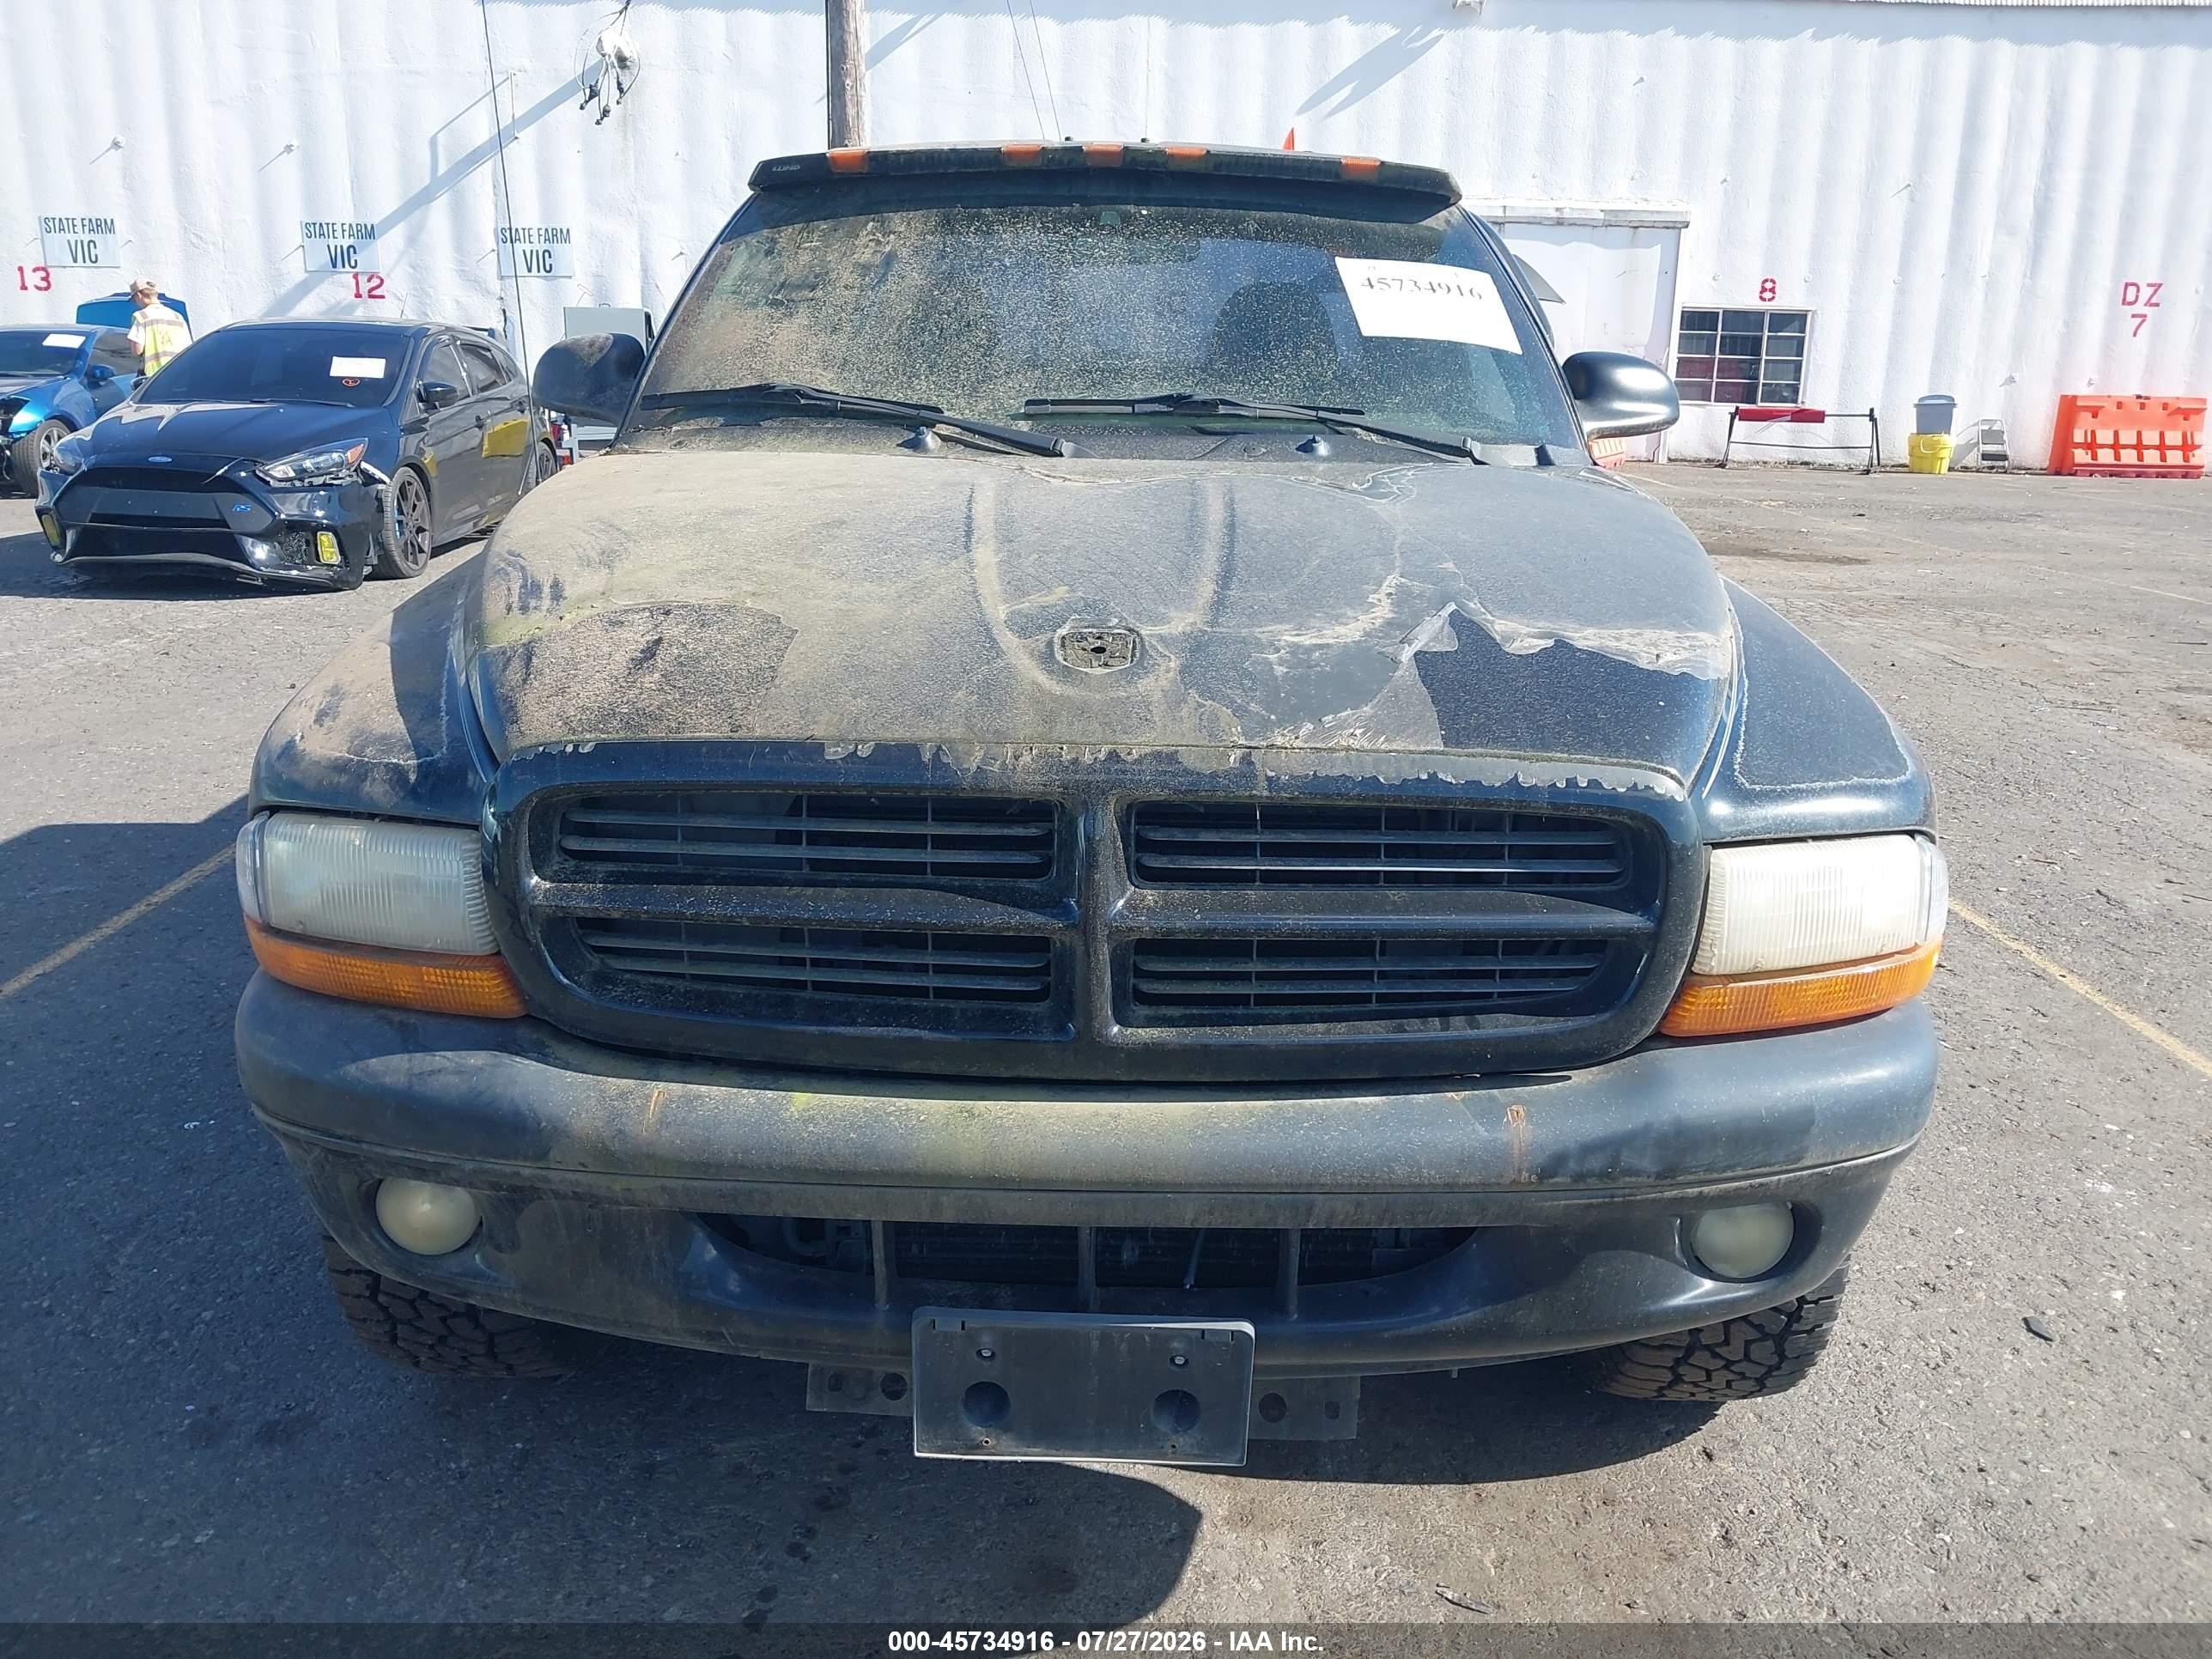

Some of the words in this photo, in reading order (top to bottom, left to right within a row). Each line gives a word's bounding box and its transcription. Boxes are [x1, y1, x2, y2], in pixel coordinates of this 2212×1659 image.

[44, 216, 78, 234] STATE
[81, 218, 116, 234] FARM
[305, 222, 338, 239] STATE
[341, 222, 375, 240] FARM
[537, 228, 571, 244] FARM
[67, 240, 98, 264] VIC
[327, 244, 358, 269] VIC
[522, 249, 553, 273] VIC
[17, 265, 52, 291] 13
[352, 273, 386, 299] 12
[1759, 278, 1777, 302] 8
[2121, 282, 2164, 307] DZ
[2130, 313, 2148, 337] 7
